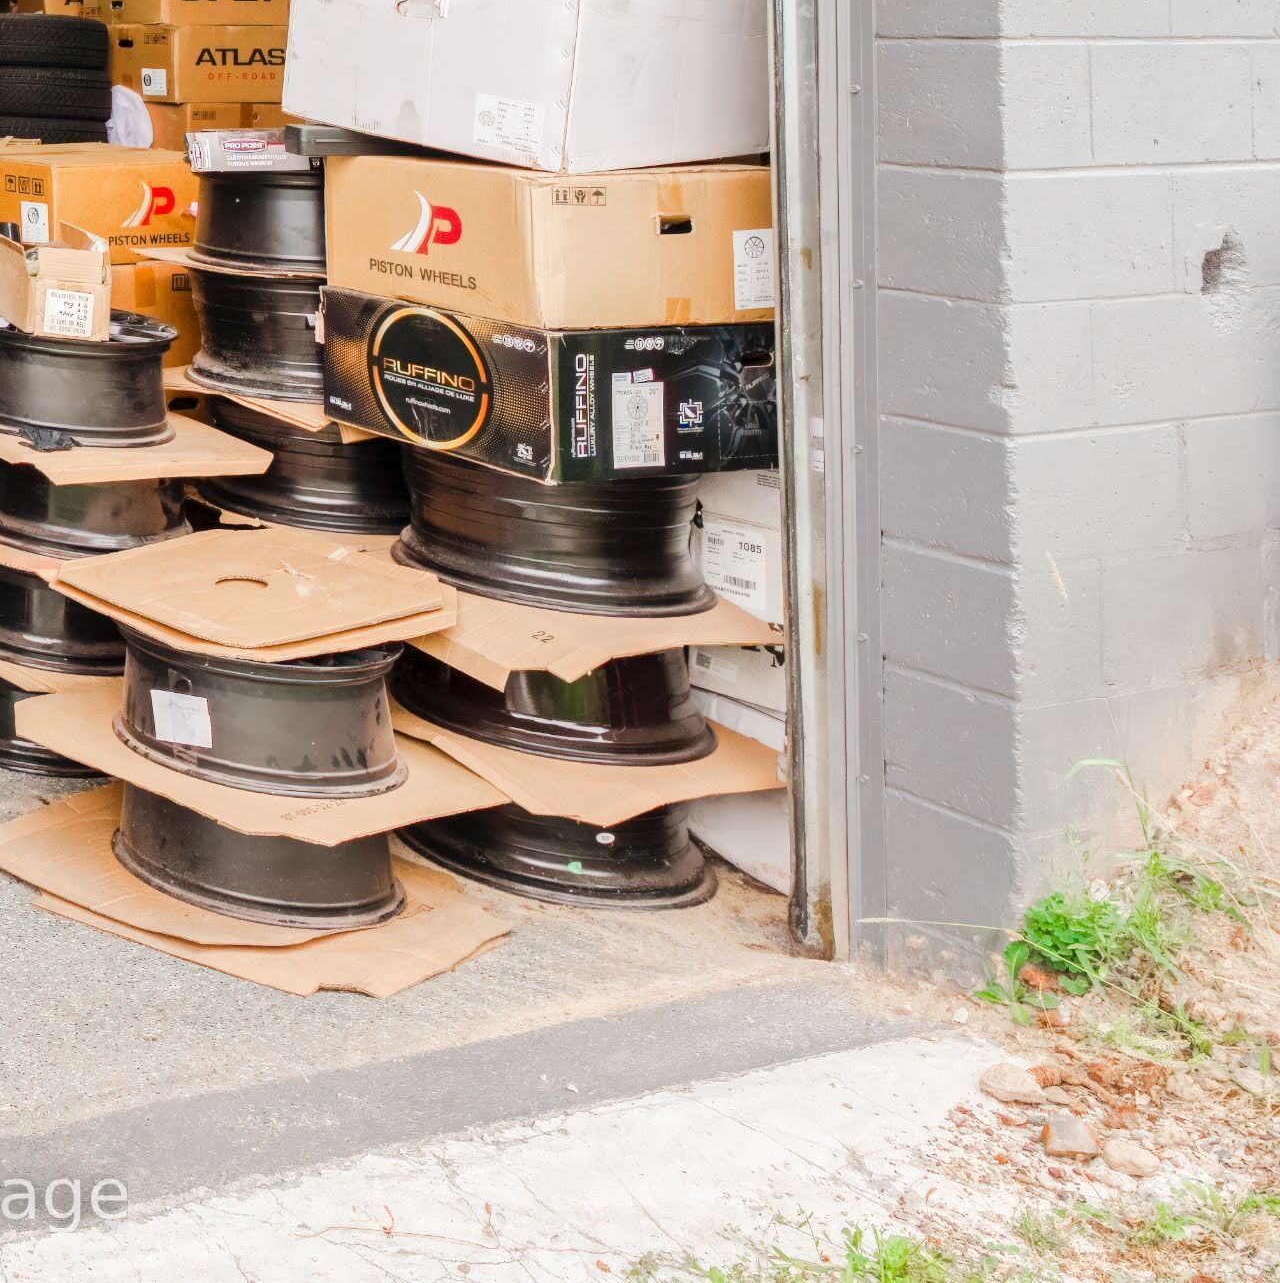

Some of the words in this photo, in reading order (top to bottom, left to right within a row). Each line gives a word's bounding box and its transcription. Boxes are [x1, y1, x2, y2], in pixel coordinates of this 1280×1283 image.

[195, 48, 285, 66] ATLAS
[108, 233, 145, 247] PISTON
[149, 231, 190, 245] WHEELS
[369, 258, 414, 277] PISTON
[419, 265, 478, 291] WHEELS
[383, 358, 475, 391] RUFFINO
[384, 374, 406, 384] ROUES
[417, 383, 444, 394] ALLIAGE
[456, 393, 474, 402] LUXE
[575, 354, 588, 458] RUFFINO
[738, 541, 762, 554] 1085
[532, 630, 554, 643] 22
